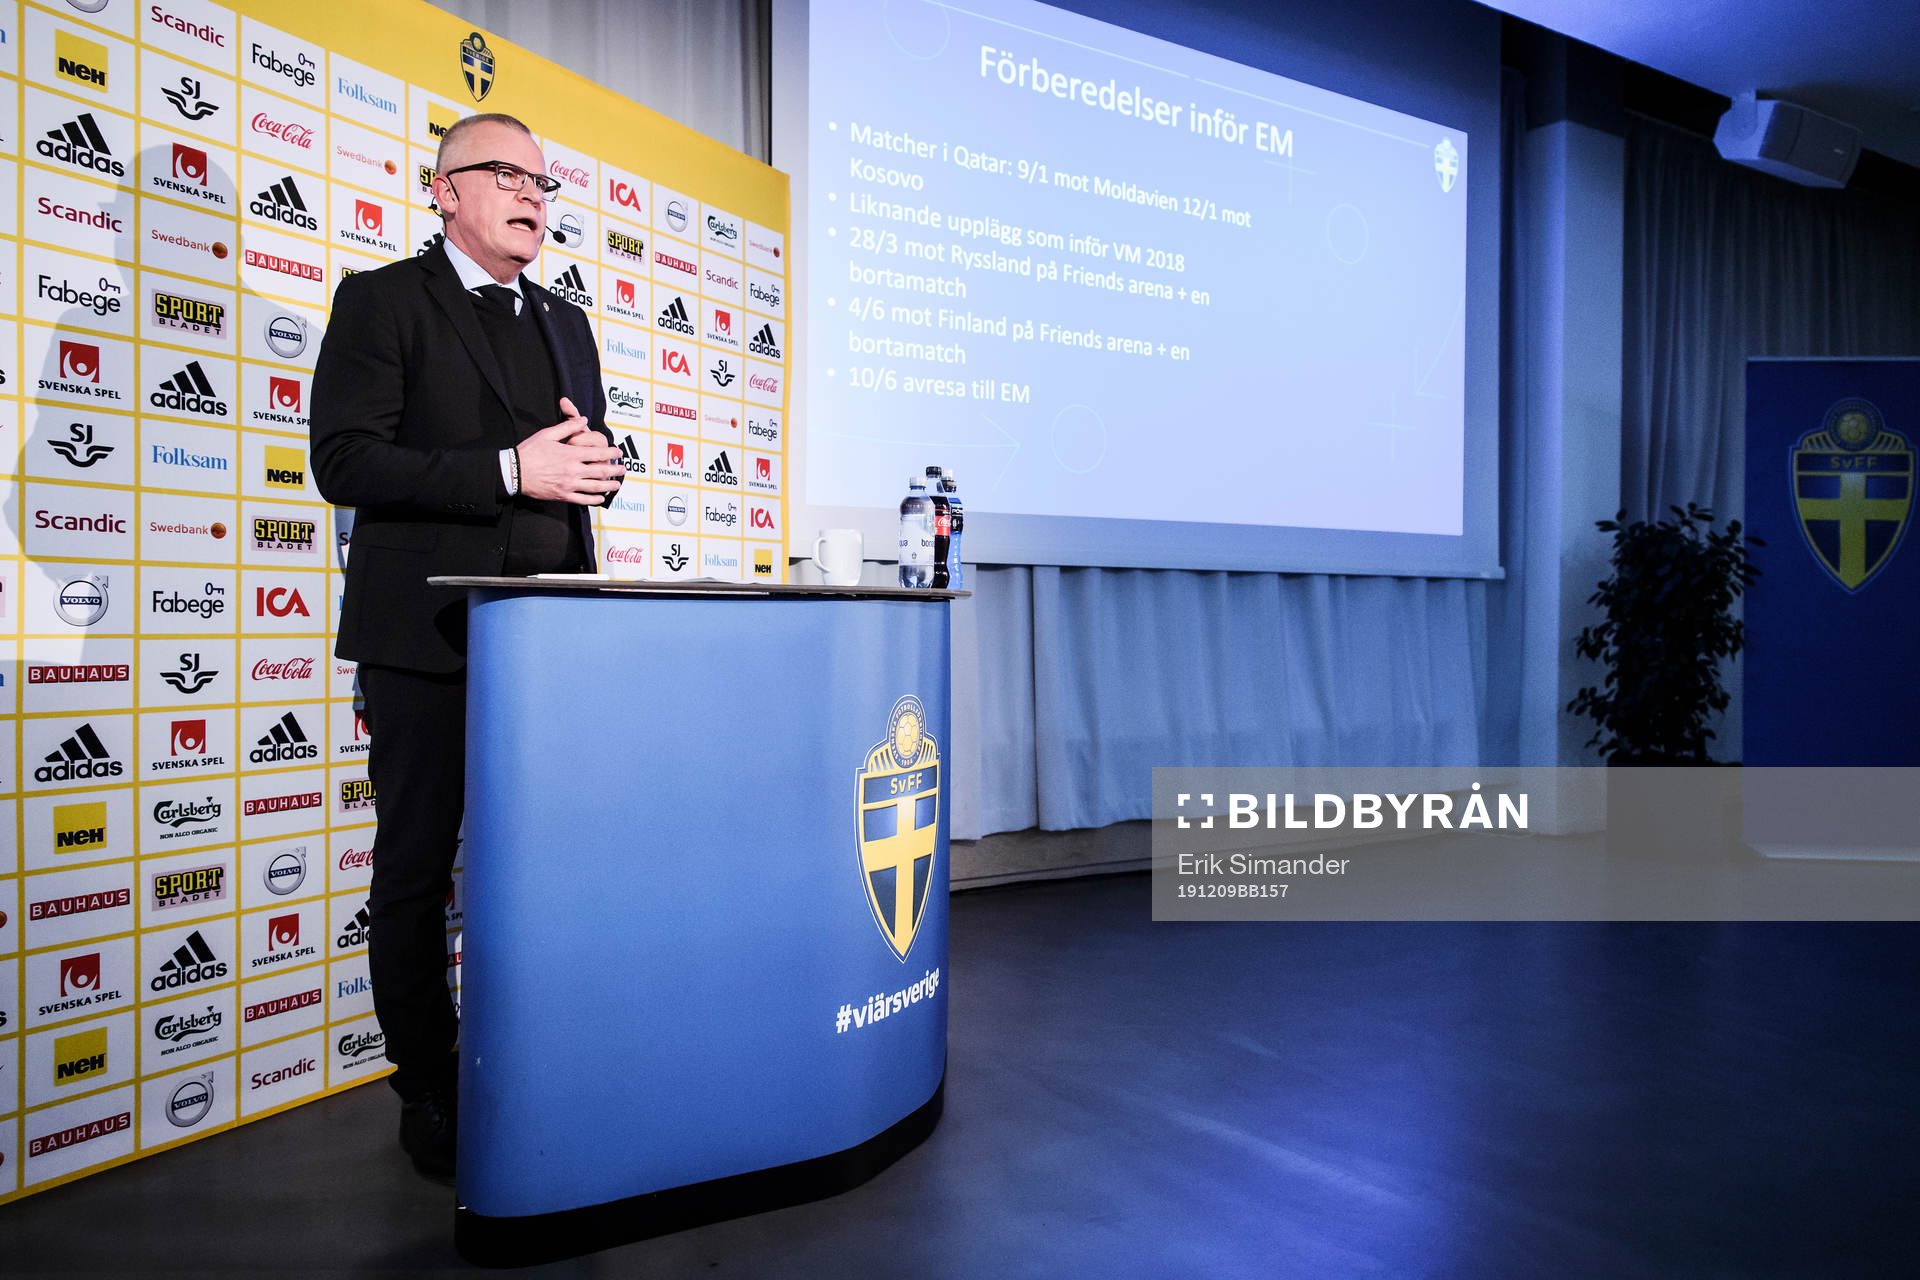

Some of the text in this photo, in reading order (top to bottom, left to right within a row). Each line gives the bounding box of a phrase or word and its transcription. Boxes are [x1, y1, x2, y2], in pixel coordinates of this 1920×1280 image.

[151, 6, 225, 47] Scandic
[251, 43, 315, 87] Fabege
[181, 77, 201, 99] SJ
[338, 78, 397, 114] Folksam
[980, 45, 1293, 158] Förberedelser inför EM
[251, 112, 313, 149] Coca-Cola
[36, 140, 125, 177] adidas
[337, 146, 382, 168] Swedbank
[550, 160, 590, 188] Coca-Cola
[851, 158, 924, 191] Kosovo
[851, 122, 1251, 228] Matcher i Qatar: 9/1 mot Moldavien 12/1 mot
[153, 177, 226, 205] SVENSKA SPEL
[610, 179, 641, 212] ICA
[38, 197, 123, 233] Scandic
[250, 198, 318, 231] adidas
[708, 216, 737, 239] Carlsberg
[850, 192, 1185, 273] Liknande upplägg som inför VM 2018
[151, 229, 211, 252] Swedbank
[340, 230, 397, 252] SVENSKA SPEL
[608, 231, 643, 255] SPORT
[246, 250, 322, 281] BAUHAUS
[610, 249, 642, 263] BLADET
[655, 252, 697, 276] BAUHAUS
[849, 227, 1210, 306] 28/3 mot Ryssland på Friends arena + en
[706, 269, 738, 290] Scandic
[849, 261, 967, 298] bortamatch
[38, 274, 121, 316] Fabege
[550, 286, 593, 307] adidas
[750, 283, 780, 307] Fabege
[155, 294, 224, 326] SPORT
[607, 304, 644, 321] SVENSKA SPEL
[159, 318, 222, 336] BLADET
[270, 328, 301, 341] VOLVO
[658, 316, 694, 335] adidas
[848, 297, 1190, 361] 4/6 mot Finland på Friends arena + en
[606, 339, 646, 361] Folksam
[707, 333, 738, 346] SVENSKA SPEL
[749, 341, 781, 359] adidas
[848, 330, 966, 365] bortamatch
[662, 348, 691, 377] ICA
[719, 360, 728, 373] SJ
[38, 379, 121, 400] SVENSKA SPEL
[849, 366, 1030, 404] 10/6 avresa till EM
[150, 389, 228, 416] adidas
[608, 387, 644, 408] Carlsberg
[253, 411, 311, 426] SVENSKA SPE
[655, 403, 697, 420] BAUHAUS
[70, 423, 93, 445] SJ
[748, 420, 778, 441] Fabege
[152, 444, 227, 470] Folksam
[1831, 456, 1877, 469] SvFF
[658, 468, 680, 477] SVENSKA
[705, 469, 738, 486] adidas
[749, 481, 767, 489] SVENSKA
[611, 498, 645, 512] olksam
[35, 510, 126, 533] Scandic
[706, 507, 736, 526] Fabege
[750, 507, 775, 529] ICA
[150, 521, 209, 535] Swedbank
[254, 518, 314, 542] SPORT
[257, 541, 313, 551] BLADET
[606, 546, 644, 564] Coca-Cola
[671, 544, 680, 556] SJ
[704, 554, 738, 567] Folksam
[62, 597, 101, 605] VOLVO
[152, 590, 225, 619] Fabege
[256, 586, 310, 617] ICA
[30, 664, 128, 683] BAUHAUS
[180, 653, 200, 672] SJ
[251, 658, 315, 681] Coca-Cola
[250, 742, 318, 764] adidas
[340, 744, 370, 753] SVENSK
[34, 760, 123, 782] adidas
[152, 756, 225, 771] SVENSKA SPEL
[342, 781, 376, 801] SPO
[891, 773, 922, 795] SvFF
[153, 797, 221, 826] Carlsberg
[246, 793, 321, 815] BAUHAUS
[174, 830, 191, 838] ALCO
[192, 826, 218, 836] ORGANIC
[155, 867, 224, 898] SPORT
[270, 866, 300, 878] VOLVO
[31, 889, 129, 920] BAUHAUS
[159, 890, 221, 907] BLADET
[252, 946, 316, 968] SVENSKA SPEL
[151, 961, 227, 992] adidas
[38, 990, 122, 1016] SVENSKA SPEL
[246, 990, 321, 1020] BAUHAUS
[836, 968, 939, 1034] #viärsverige
[155, 1009, 222, 1038] Carlsberg
[338, 1032, 384, 1056] Carlsber
[251, 1058, 315, 1089] Scandic
[174, 1094, 207, 1109] VOLVO
[31, 1114, 129, 1155] BAUHAUS
